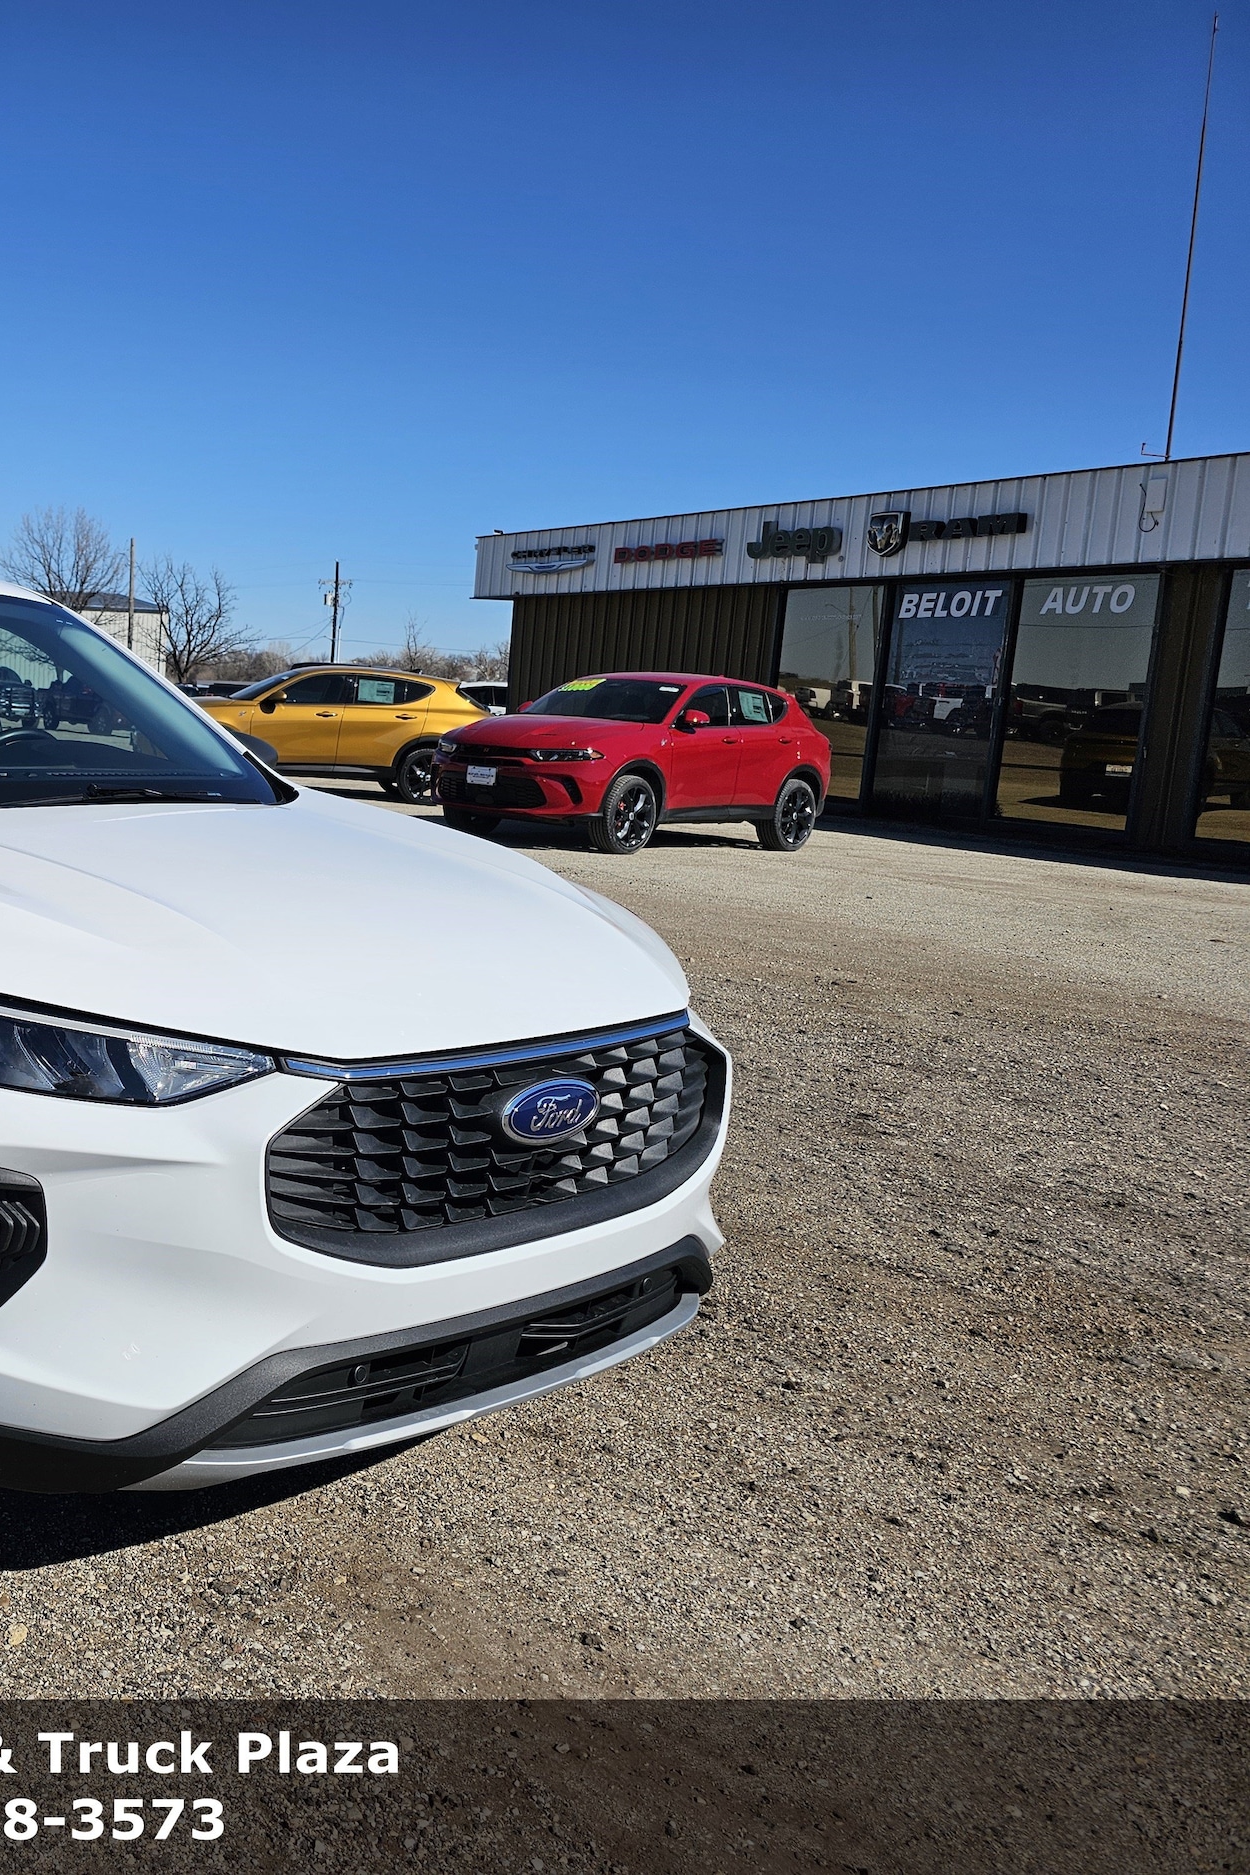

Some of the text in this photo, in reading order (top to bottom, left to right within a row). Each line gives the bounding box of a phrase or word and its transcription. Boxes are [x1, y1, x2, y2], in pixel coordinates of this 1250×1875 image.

[746, 520, 842, 563] Jeep
[909, 512, 1027, 541] RAM
[614, 538, 724, 563] DODGE
[898, 584, 1136, 619] BELOIT AUTO
[530, 1093, 583, 1133] Ford
